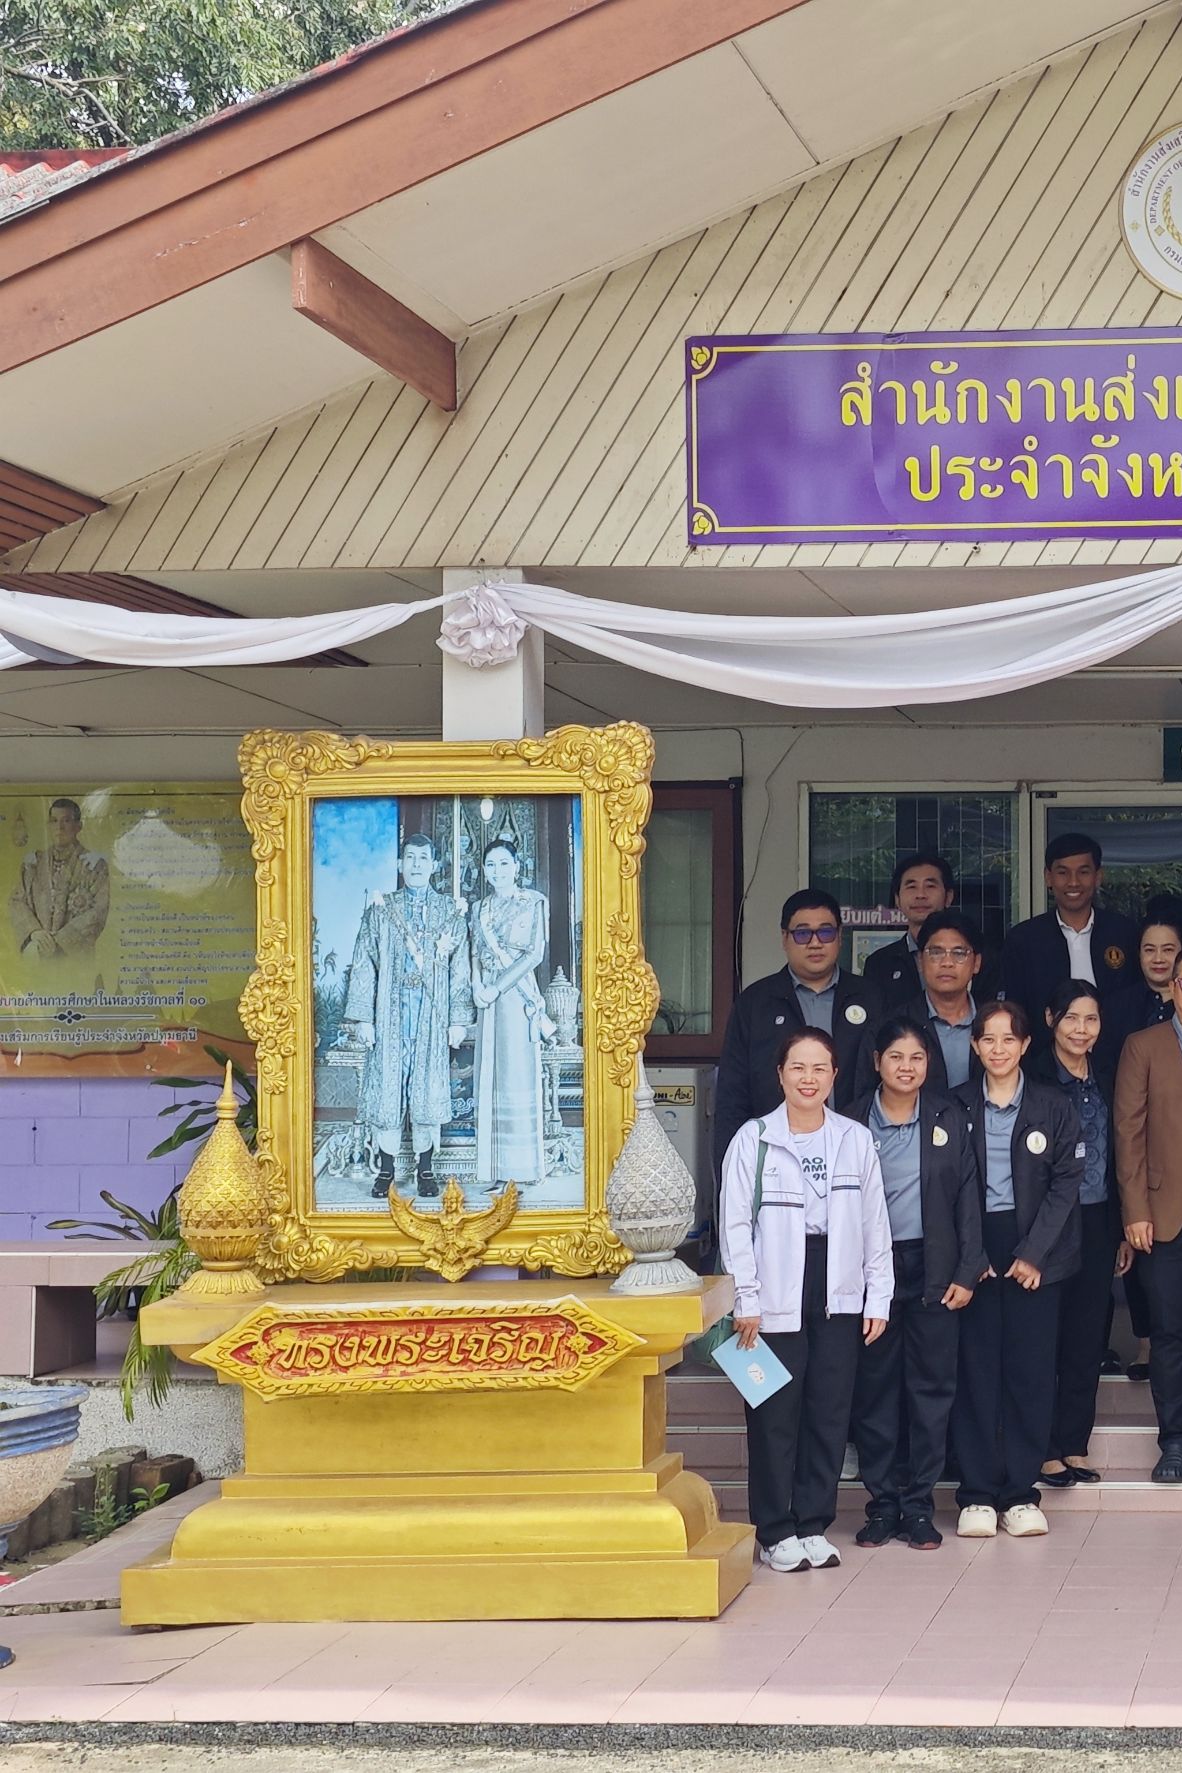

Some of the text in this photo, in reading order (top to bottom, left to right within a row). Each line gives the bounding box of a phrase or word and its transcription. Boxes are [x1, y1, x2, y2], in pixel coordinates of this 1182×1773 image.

[1149, 167, 1174, 224] DEPARTMENT
[276, 1320, 563, 1370] ทรงพระเจริญ
